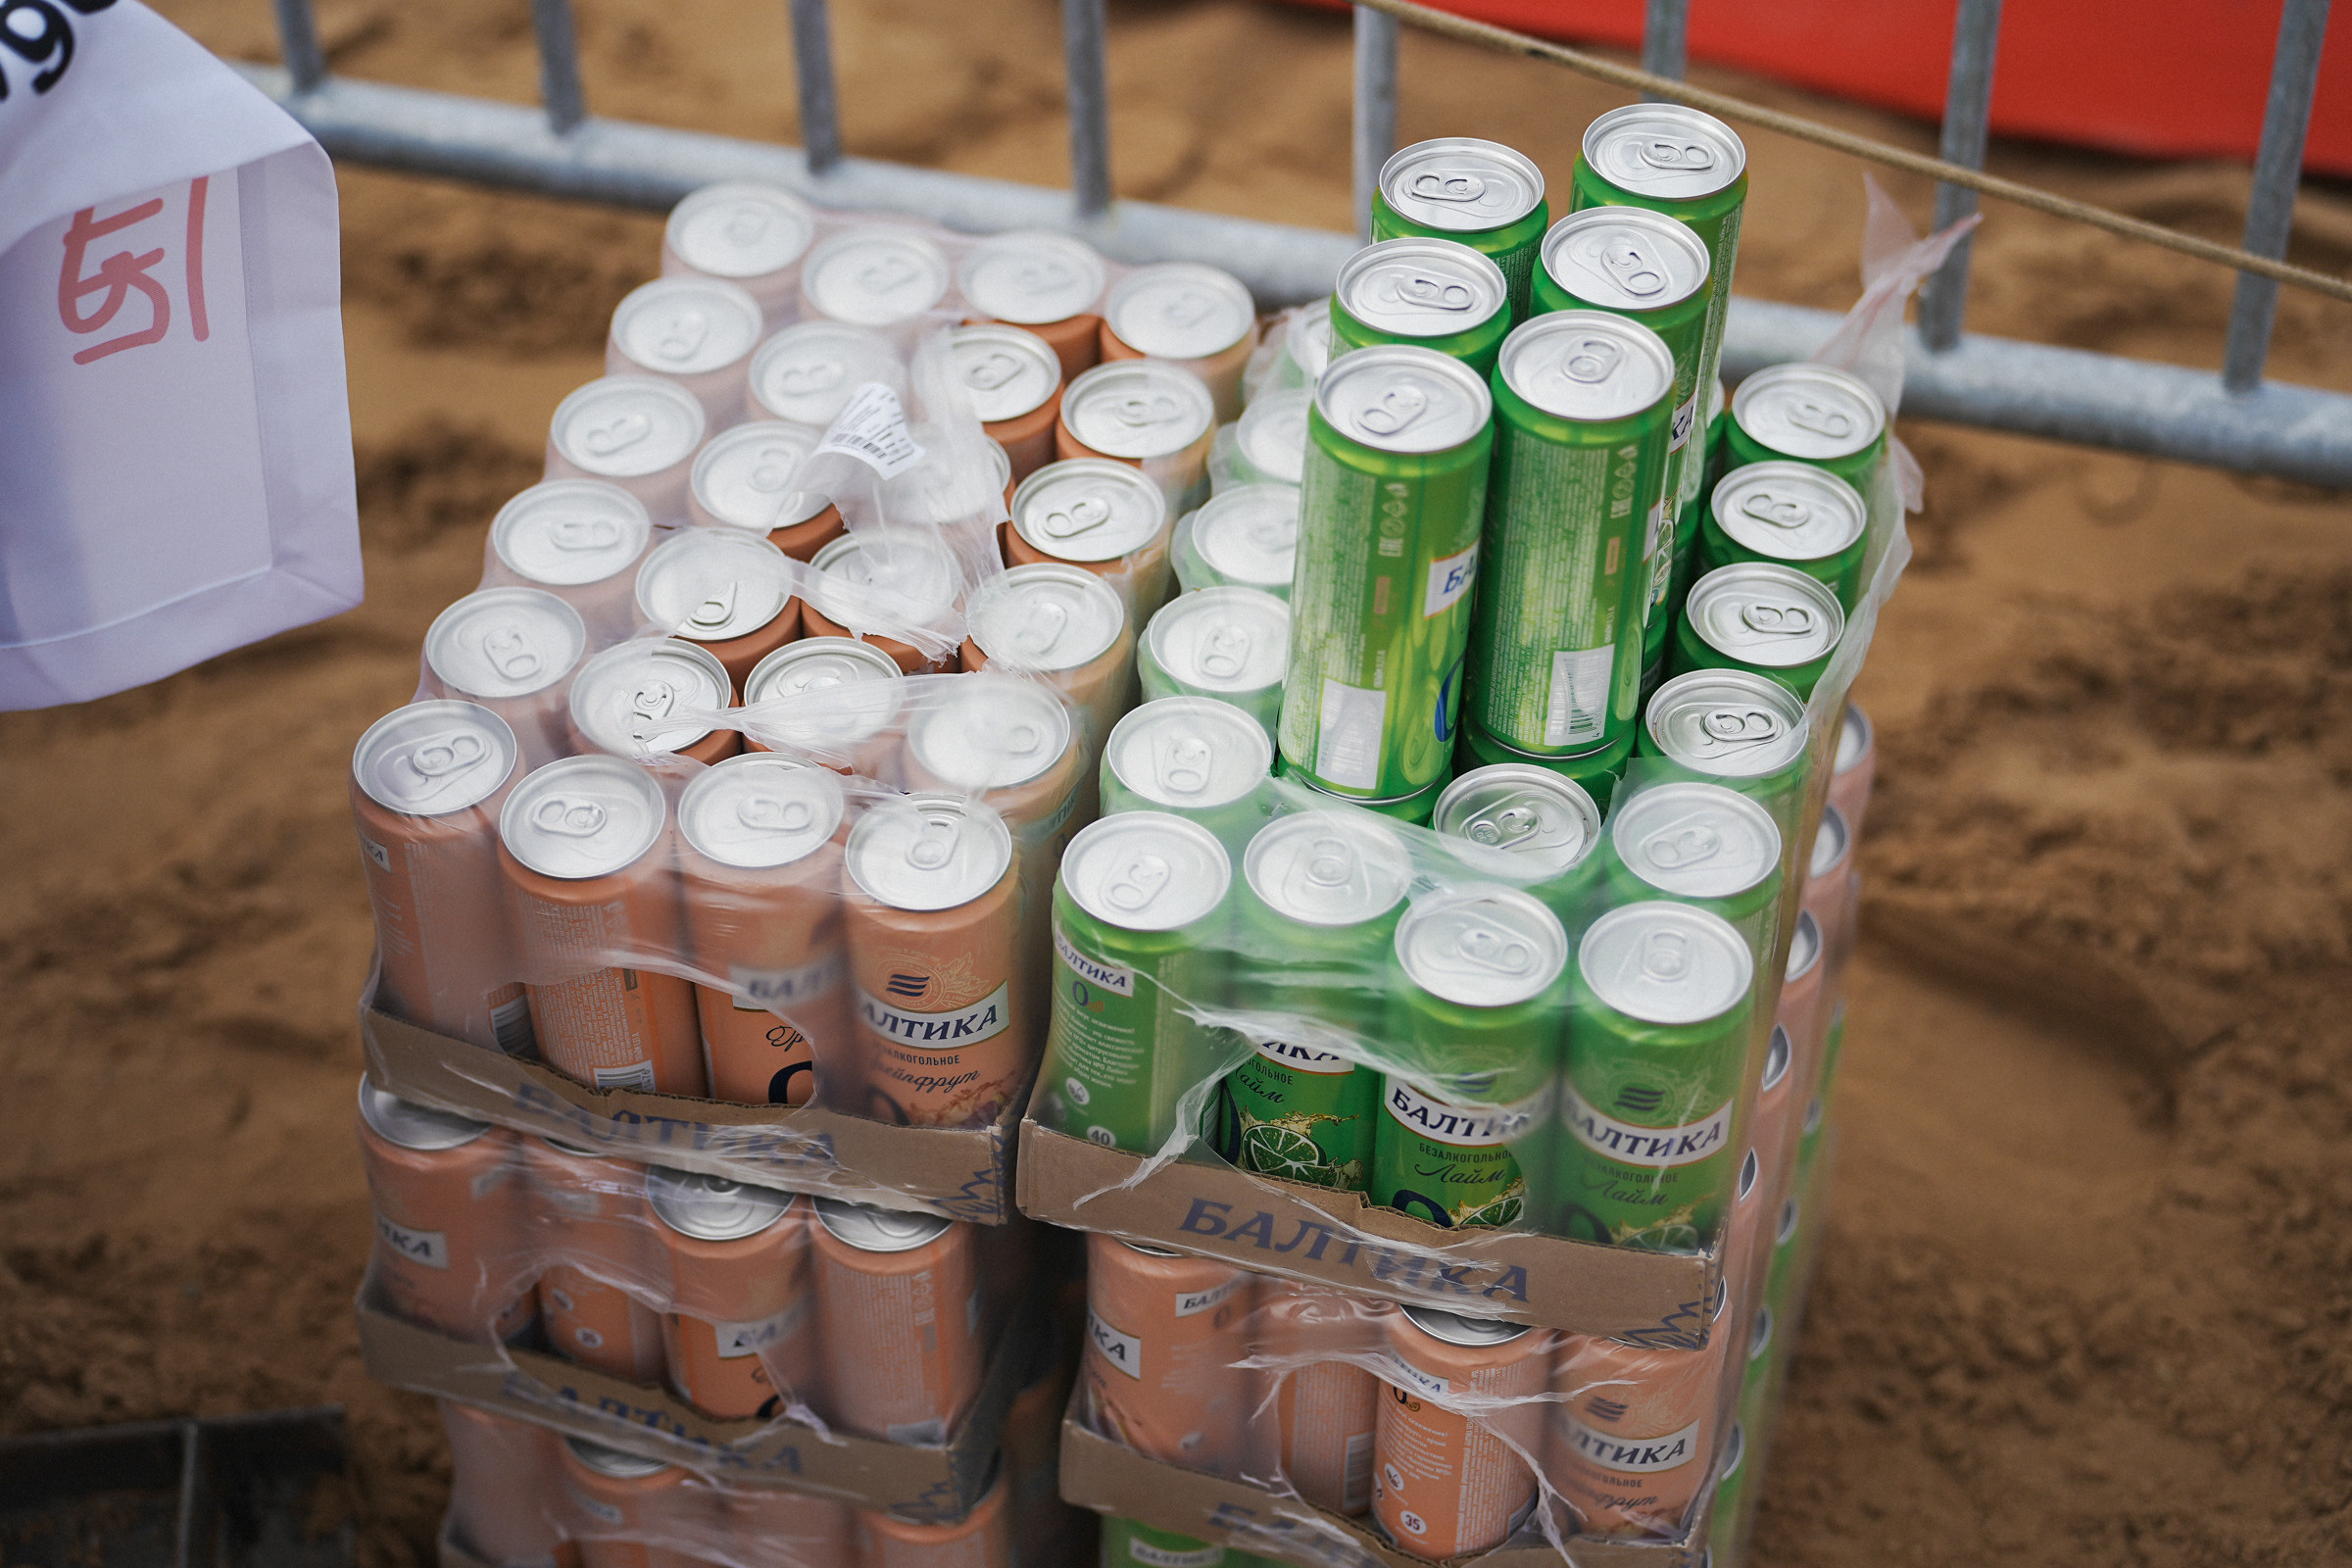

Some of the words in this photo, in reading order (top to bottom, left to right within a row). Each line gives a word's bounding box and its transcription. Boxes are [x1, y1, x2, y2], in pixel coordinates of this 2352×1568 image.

[862, 1003, 998, 1040] АЛТИКА
[1247, 1058, 1294, 1085] ОГОЛЬНОЕ
[1414, 1163, 1506, 1184] Лайм
[1179, 1198, 1531, 1303] БАЛТИКА
[1405, 1514, 1421, 1531] 35
